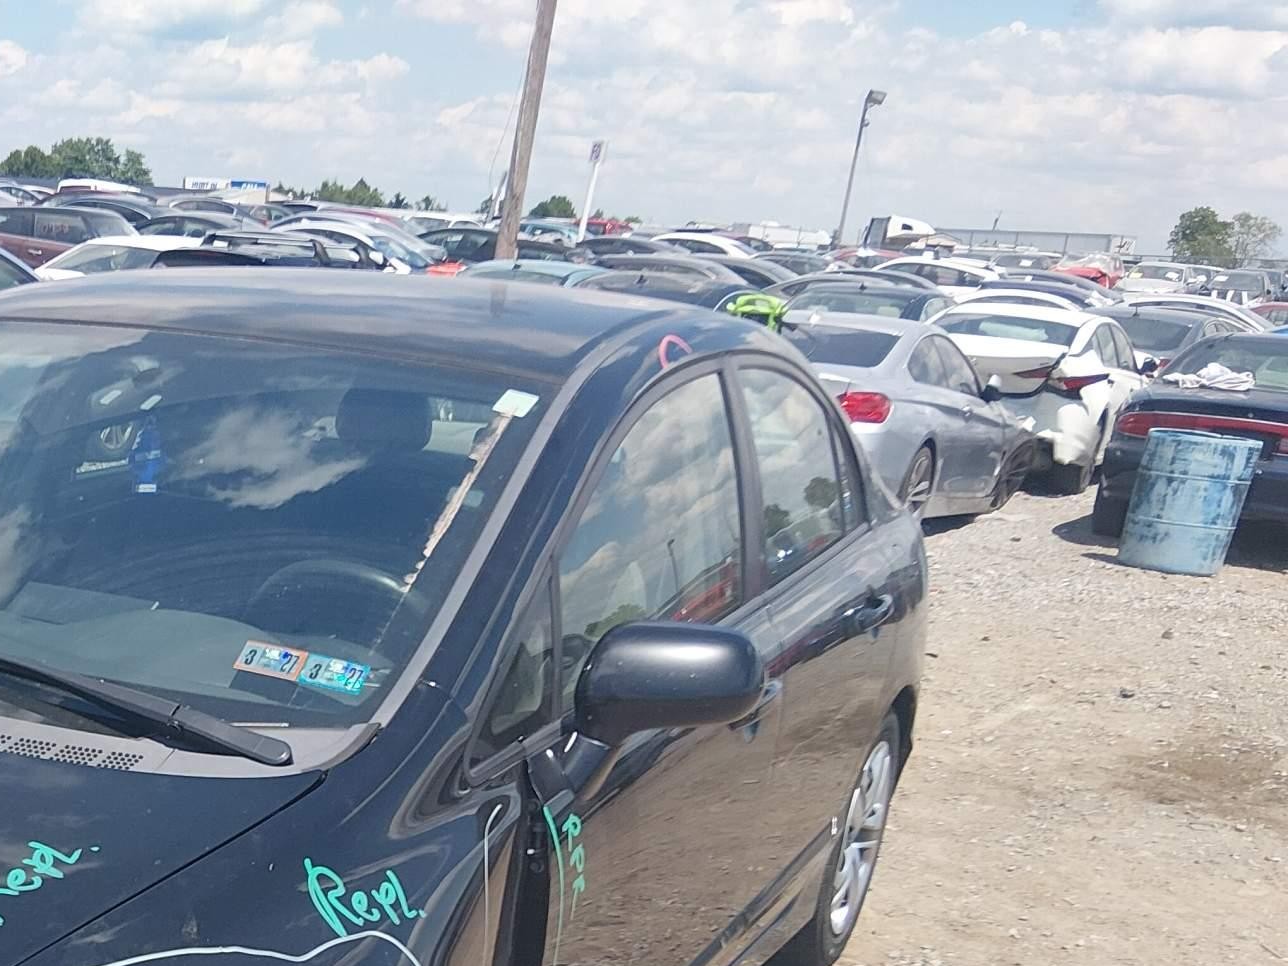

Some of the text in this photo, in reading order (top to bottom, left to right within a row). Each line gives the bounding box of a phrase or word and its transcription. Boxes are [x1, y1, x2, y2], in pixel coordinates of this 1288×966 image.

[244, 649, 258, 665] 3
[280, 653, 300, 674] 27
[309, 663, 322, 680] 3
